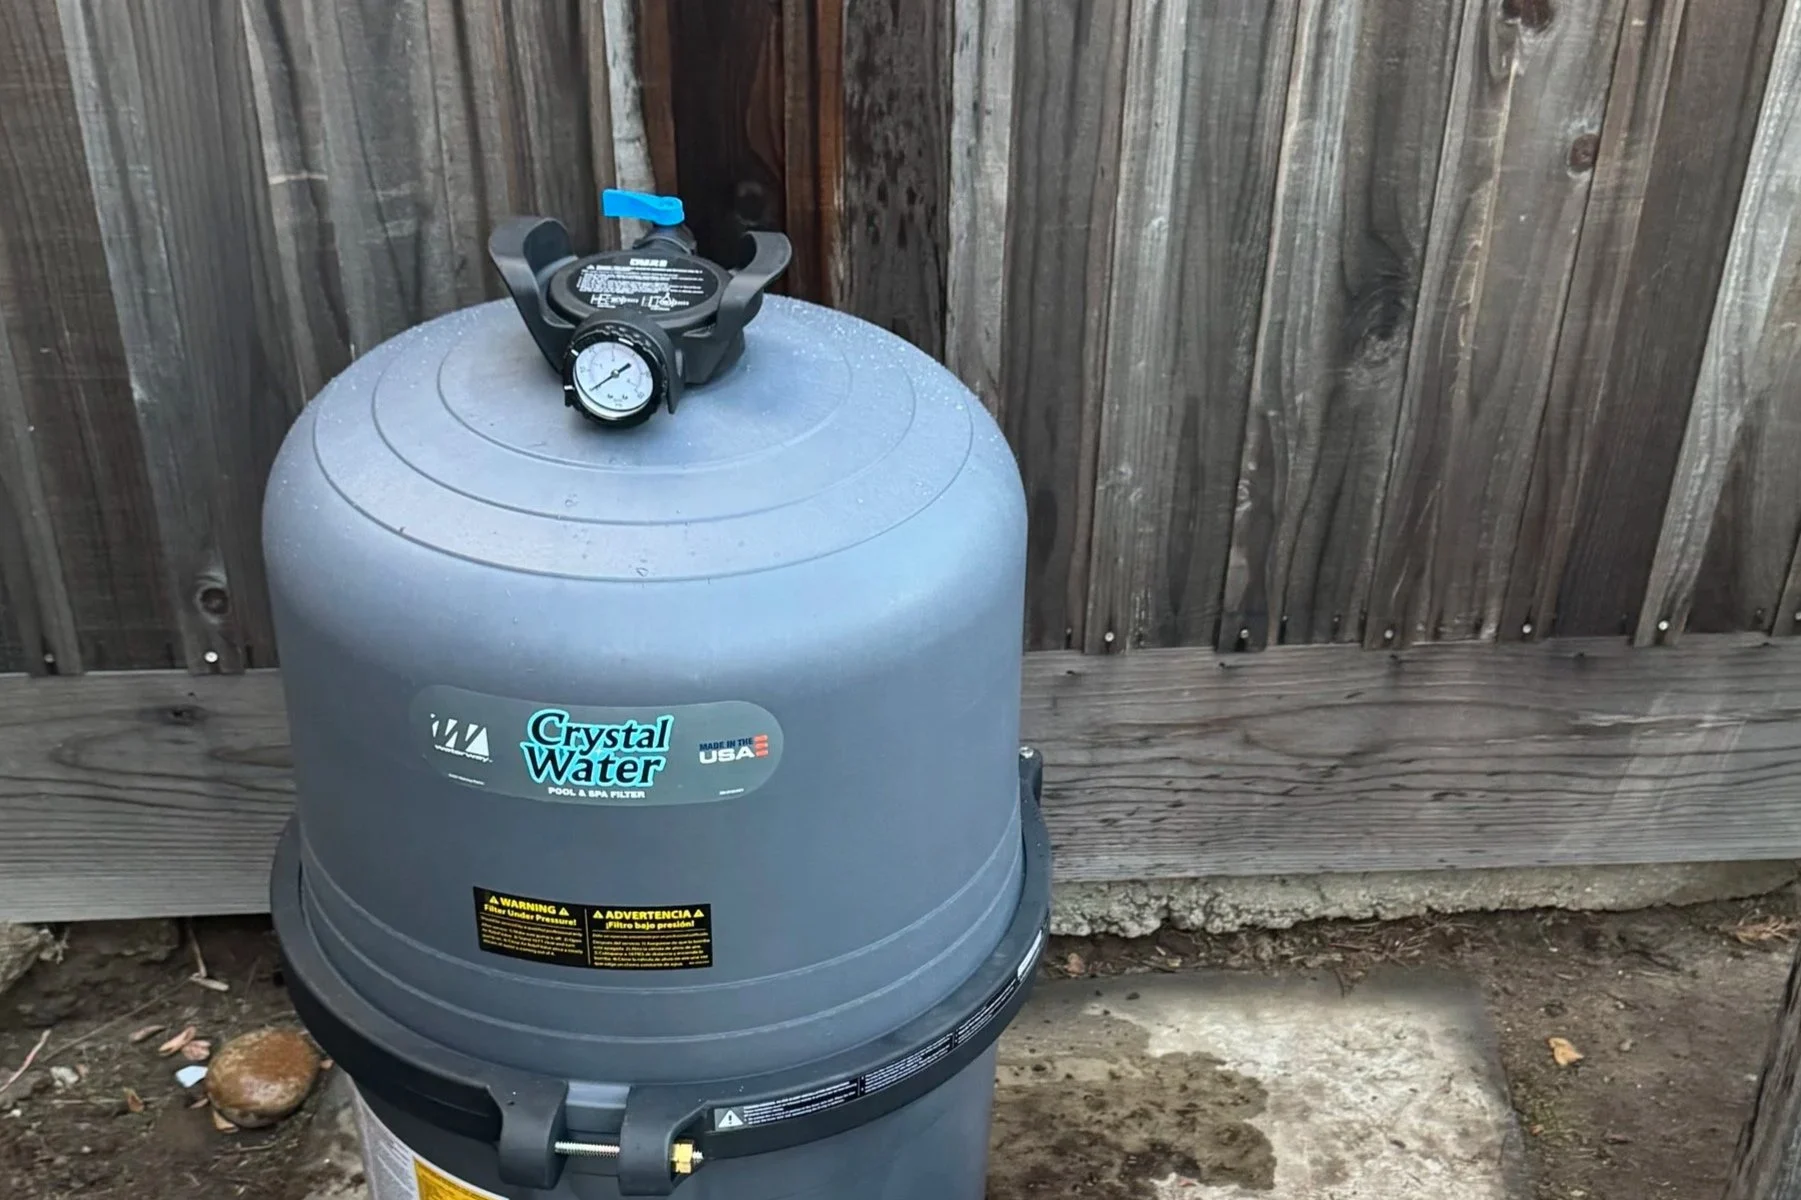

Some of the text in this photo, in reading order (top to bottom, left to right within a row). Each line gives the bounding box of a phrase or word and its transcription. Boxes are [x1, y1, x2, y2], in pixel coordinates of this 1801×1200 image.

[528, 709, 674, 756] Crystal
[699, 737, 753, 751] MADE IN THE
[699, 746, 755, 764] USA
[520, 742, 667, 787] Water
[548, 787, 645, 799] POOL & SPA FILTER
[484, 904, 577, 926] Filter Under Pressure!
[499, 897, 556, 915] WARNING
[605, 909, 692, 920] ADVERTENCIA
[606, 920, 695, 931] ¡Filtro bajo presión!
